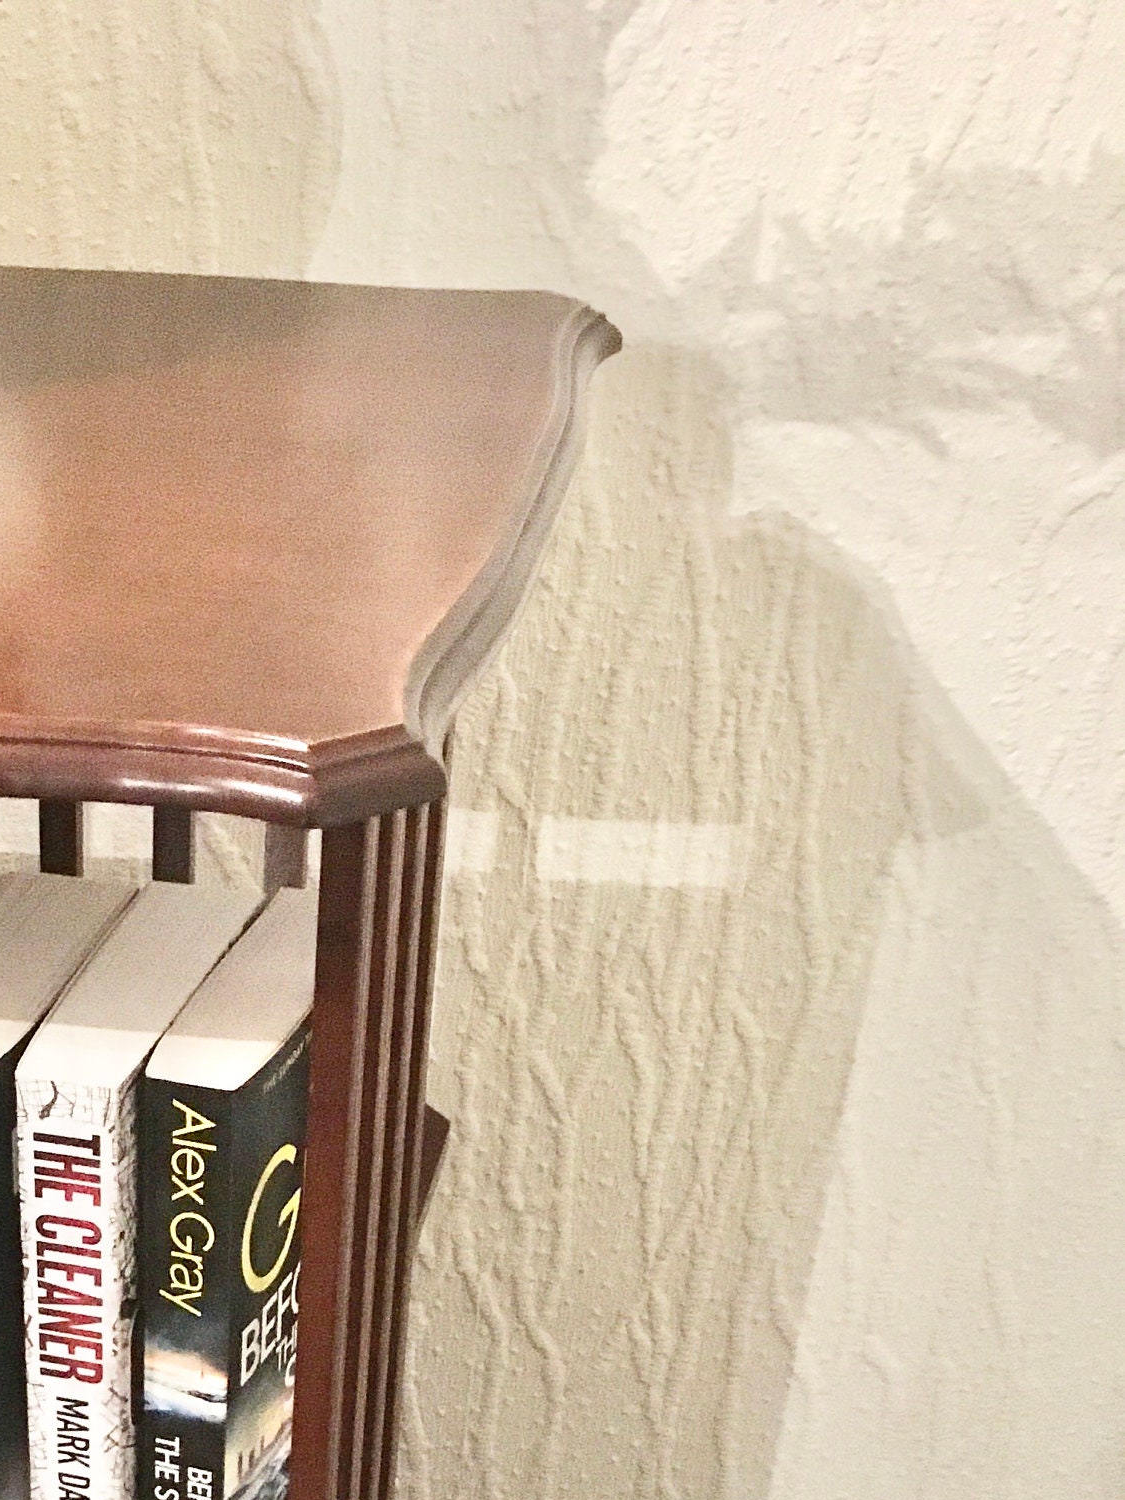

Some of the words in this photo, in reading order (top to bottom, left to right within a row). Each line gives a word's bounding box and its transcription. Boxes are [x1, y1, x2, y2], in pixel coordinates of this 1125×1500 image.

[33, 1131, 101, 1206] THE
[171, 1097, 217, 1205] Alex
[35, 1214, 103, 1384] CLEANER
[159, 1211, 215, 1317] Gray
[240, 1261, 301, 1387] BEF
[276, 1320, 298, 1371] TH
[56, 1396, 90, 1468] MARK
[154, 1436, 180, 1483] THE
